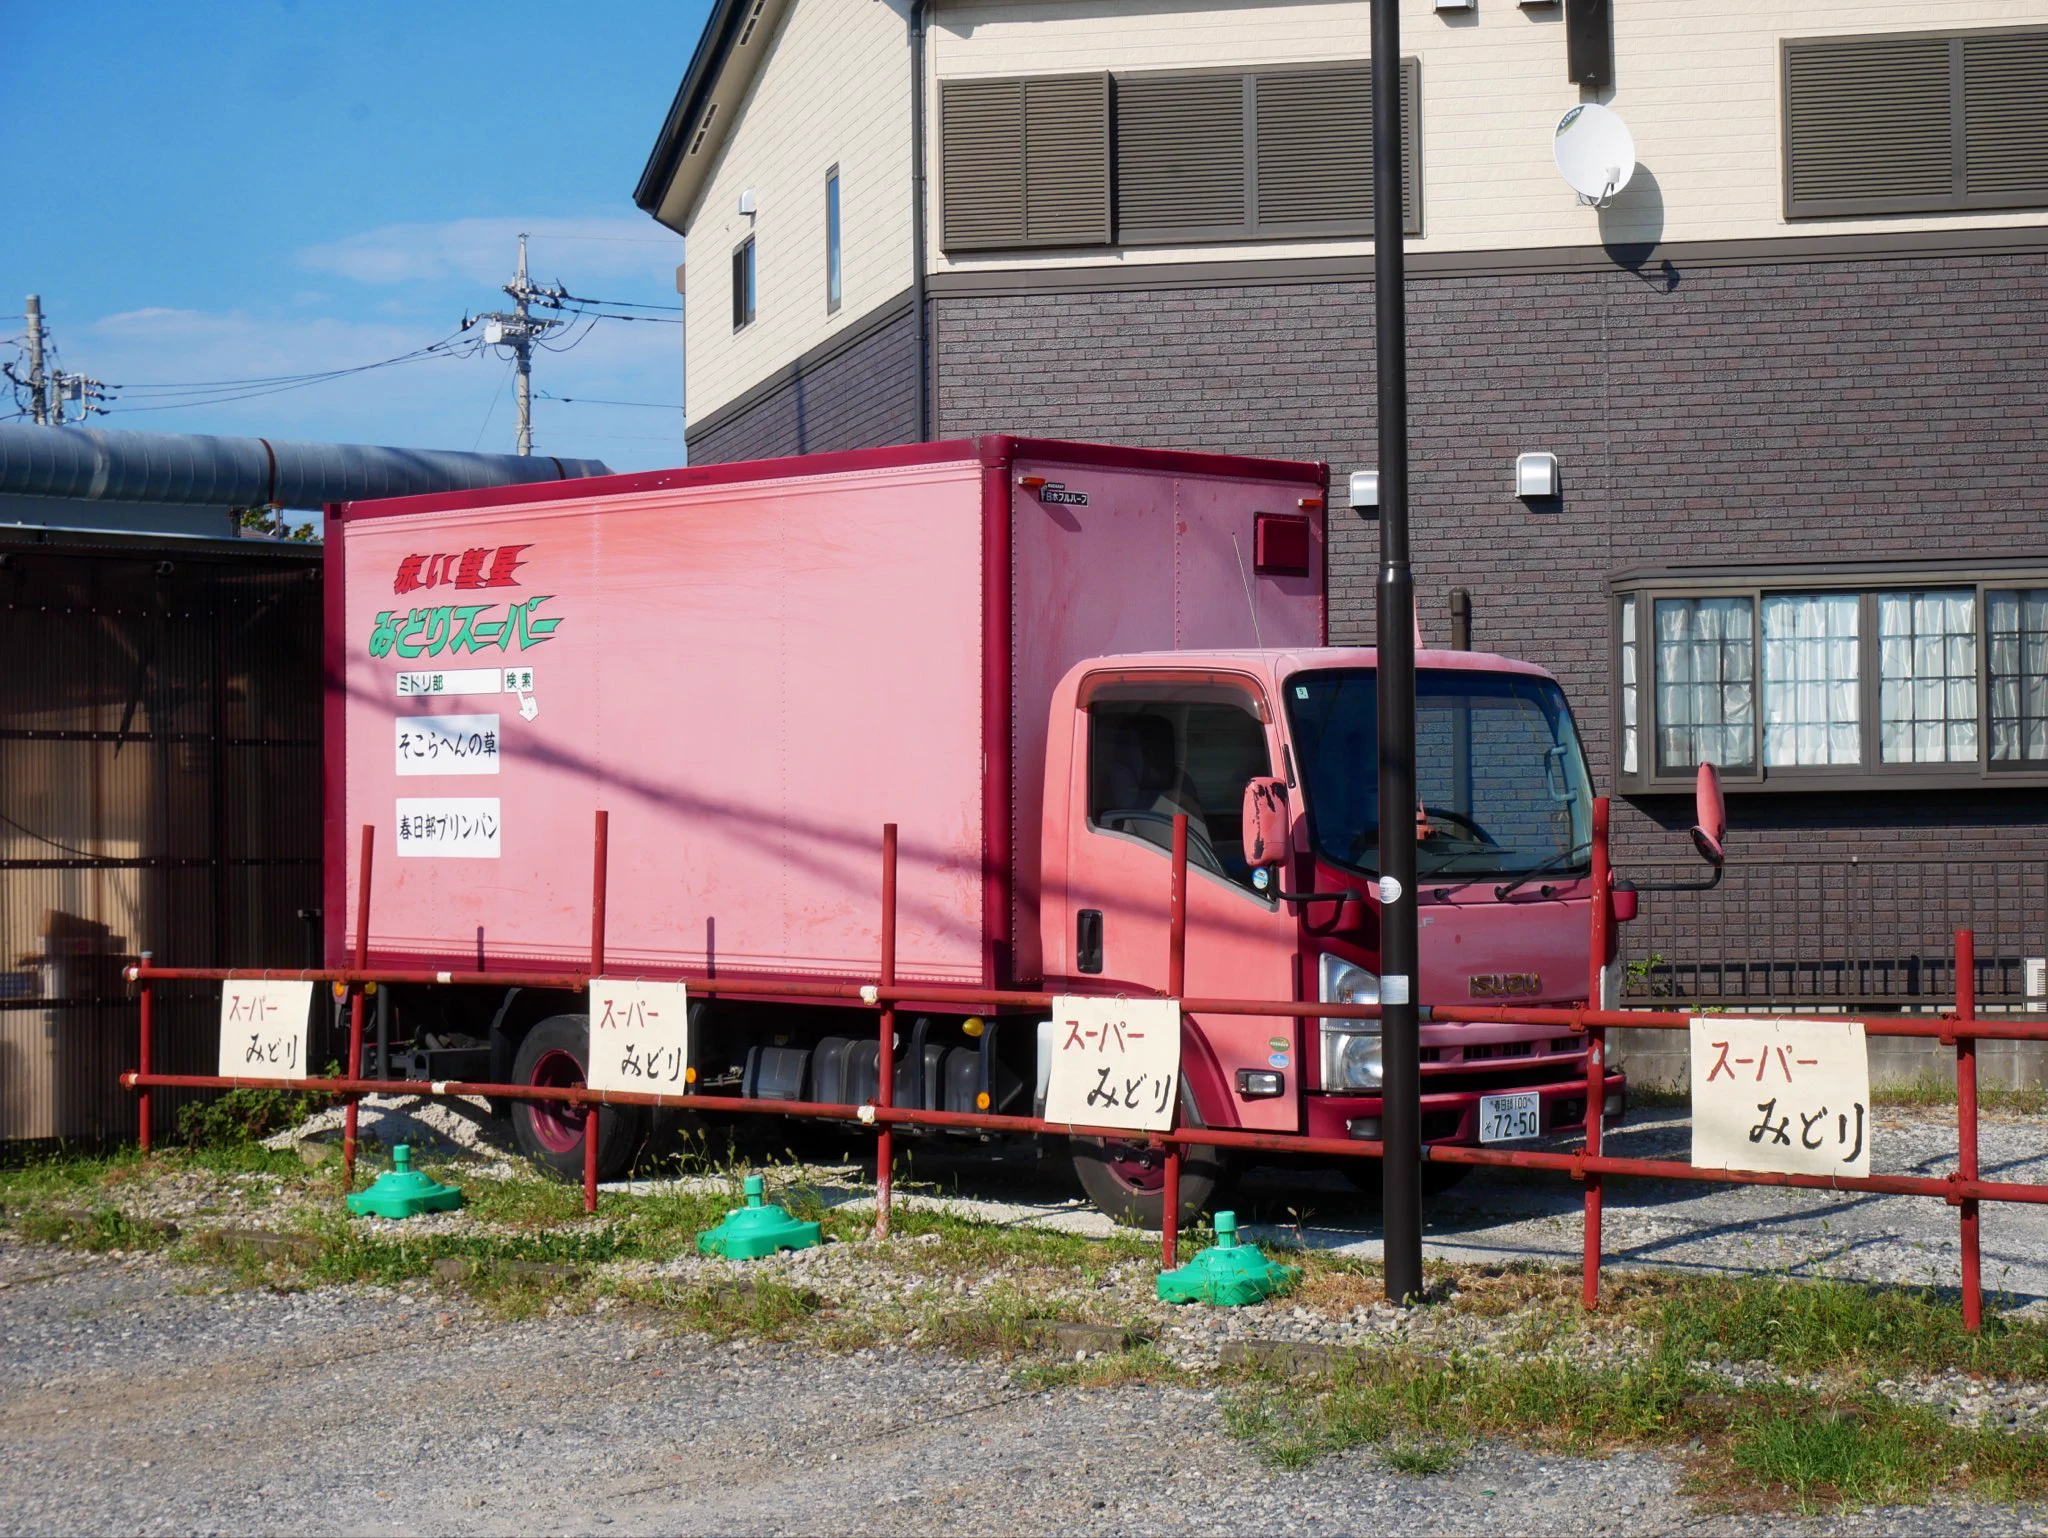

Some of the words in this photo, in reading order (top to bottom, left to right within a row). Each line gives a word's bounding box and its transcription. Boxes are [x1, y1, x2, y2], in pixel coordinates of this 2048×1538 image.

[1046, 492, 1087, 504] 日本フルハーフ
[394, 544, 535, 595] 赤い彗星
[369, 595, 564, 659] みどりスーパー
[399, 674, 443, 693] ミドリ部
[506, 672, 532, 688] 検索
[399, 731, 497, 759] そこらへんの草
[400, 813, 498, 841] 春日部プリンパン
[1468, 973, 1541, 997] ISUZU
[229, 995, 278, 1022] スーパー
[600, 999, 659, 1029] スーパー
[245, 1033, 298, 1070] みどり
[1062, 1020, 1145, 1053] スーパー
[621, 1043, 683, 1082] みどり
[1706, 1041, 1818, 1083] スーパー
[1086, 1066, 1172, 1114] みどり
[1748, 1097, 1865, 1163] みどり
